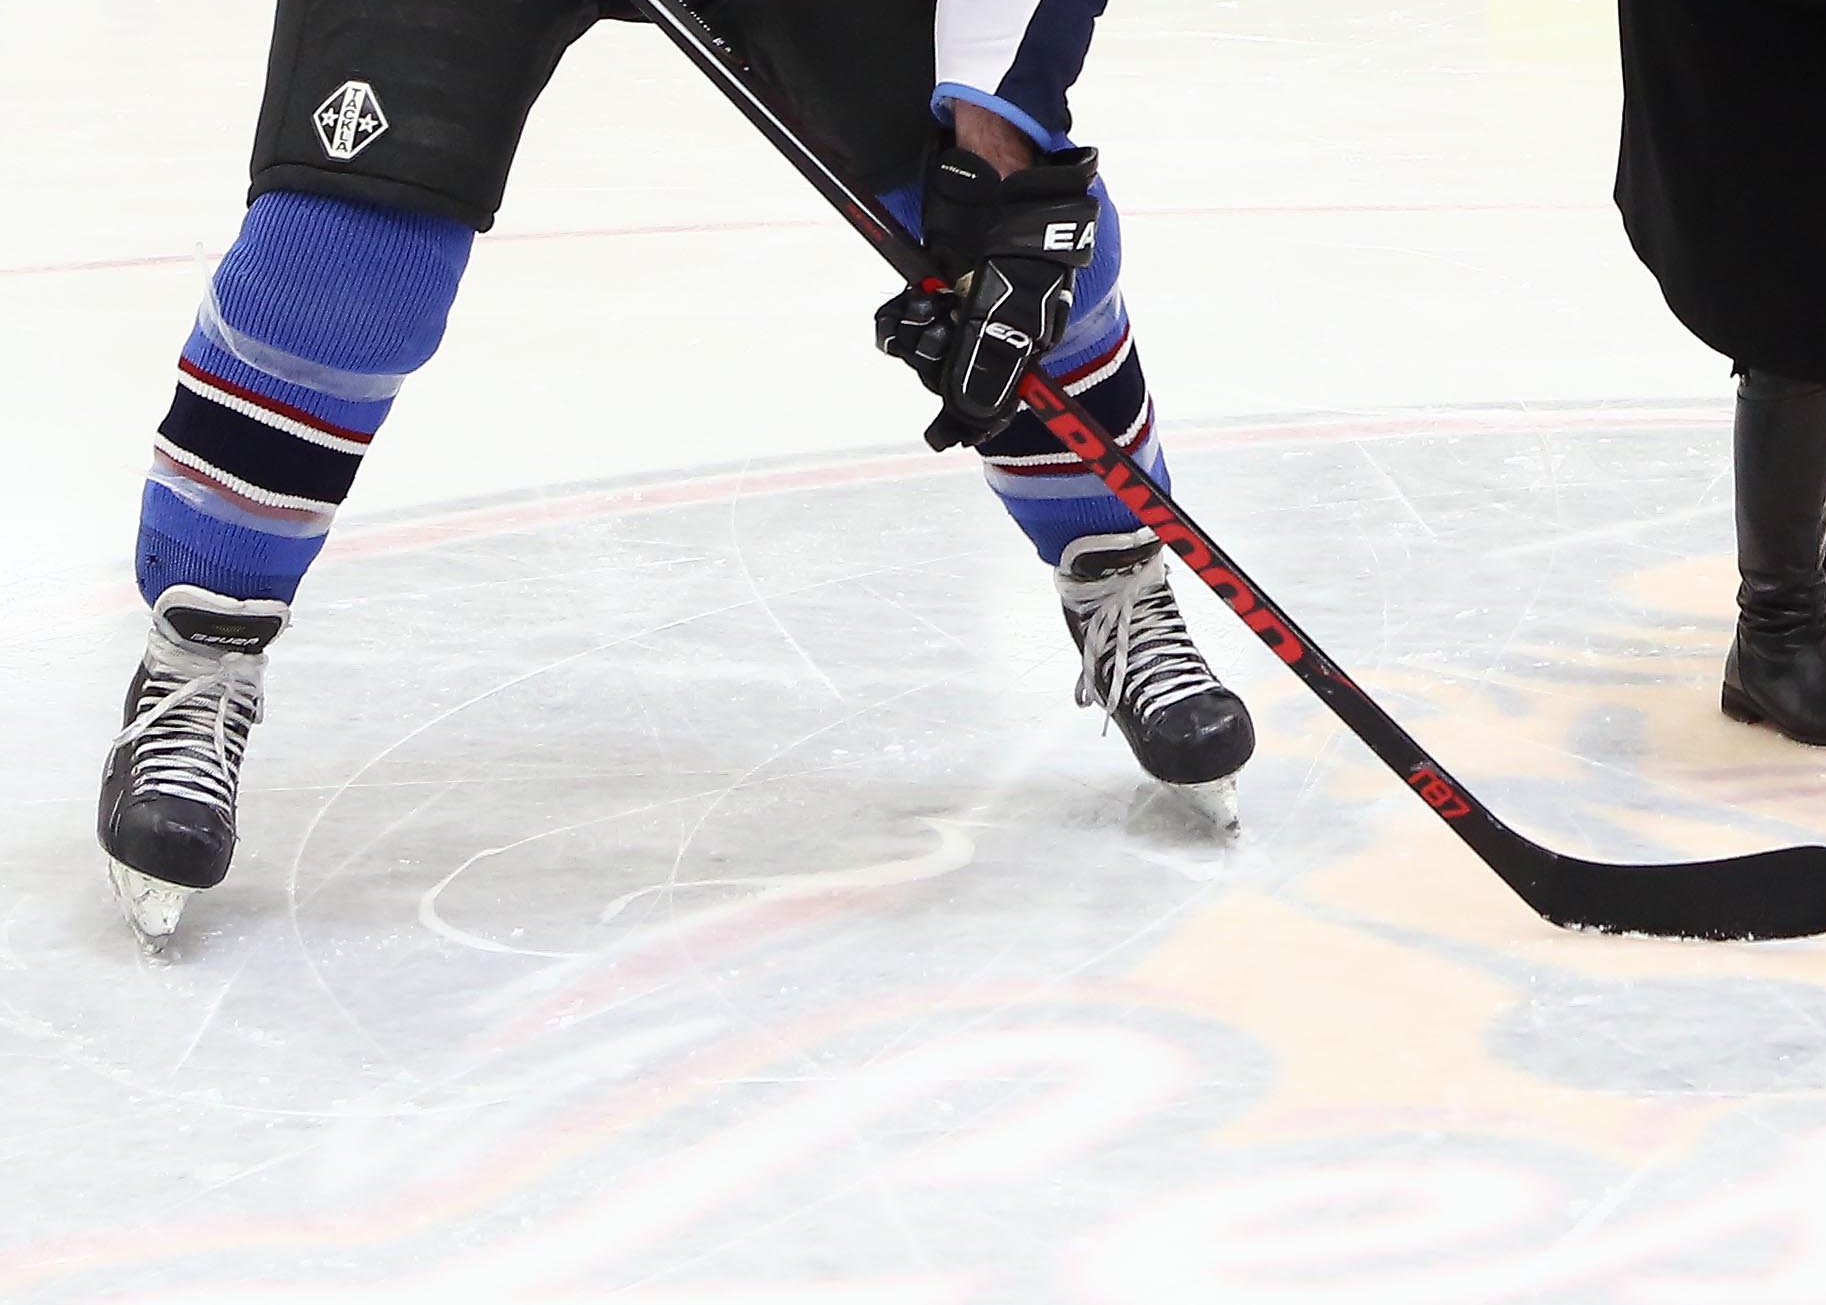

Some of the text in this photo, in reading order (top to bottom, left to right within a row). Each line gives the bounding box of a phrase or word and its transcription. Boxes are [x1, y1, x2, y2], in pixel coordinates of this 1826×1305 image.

[334, 87, 362, 153] TACKLA
[191, 633, 260, 646] BAUER
[1407, 768, 1472, 818] T87
